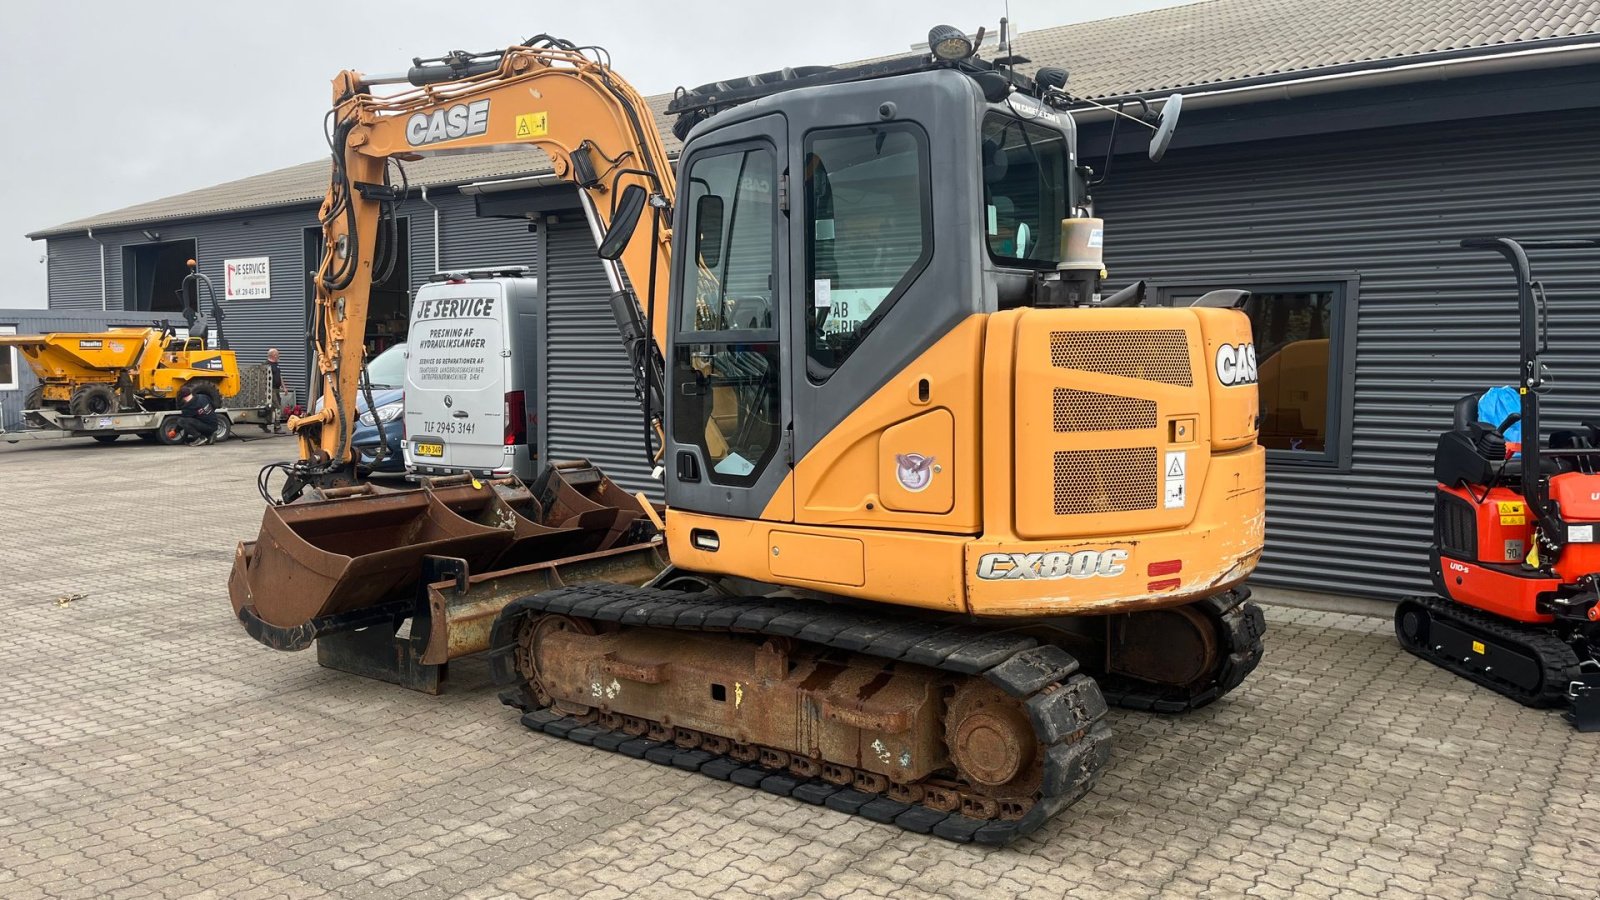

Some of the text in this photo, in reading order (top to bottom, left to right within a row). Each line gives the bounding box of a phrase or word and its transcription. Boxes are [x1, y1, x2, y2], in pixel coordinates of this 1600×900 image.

[406, 99, 490, 146] CASE
[235, 263, 266, 275] JE SERVICE
[417, 298, 495, 319] JE SERVICE
[430, 328, 474, 338] PRESNING AF
[420, 338, 486, 349] HYDRAULIKSLANGER
[1216, 343, 1257, 387] CAS
[424, 421, 475, 434] TLF 2945 3141
[976, 549, 1128, 579] CX80C
